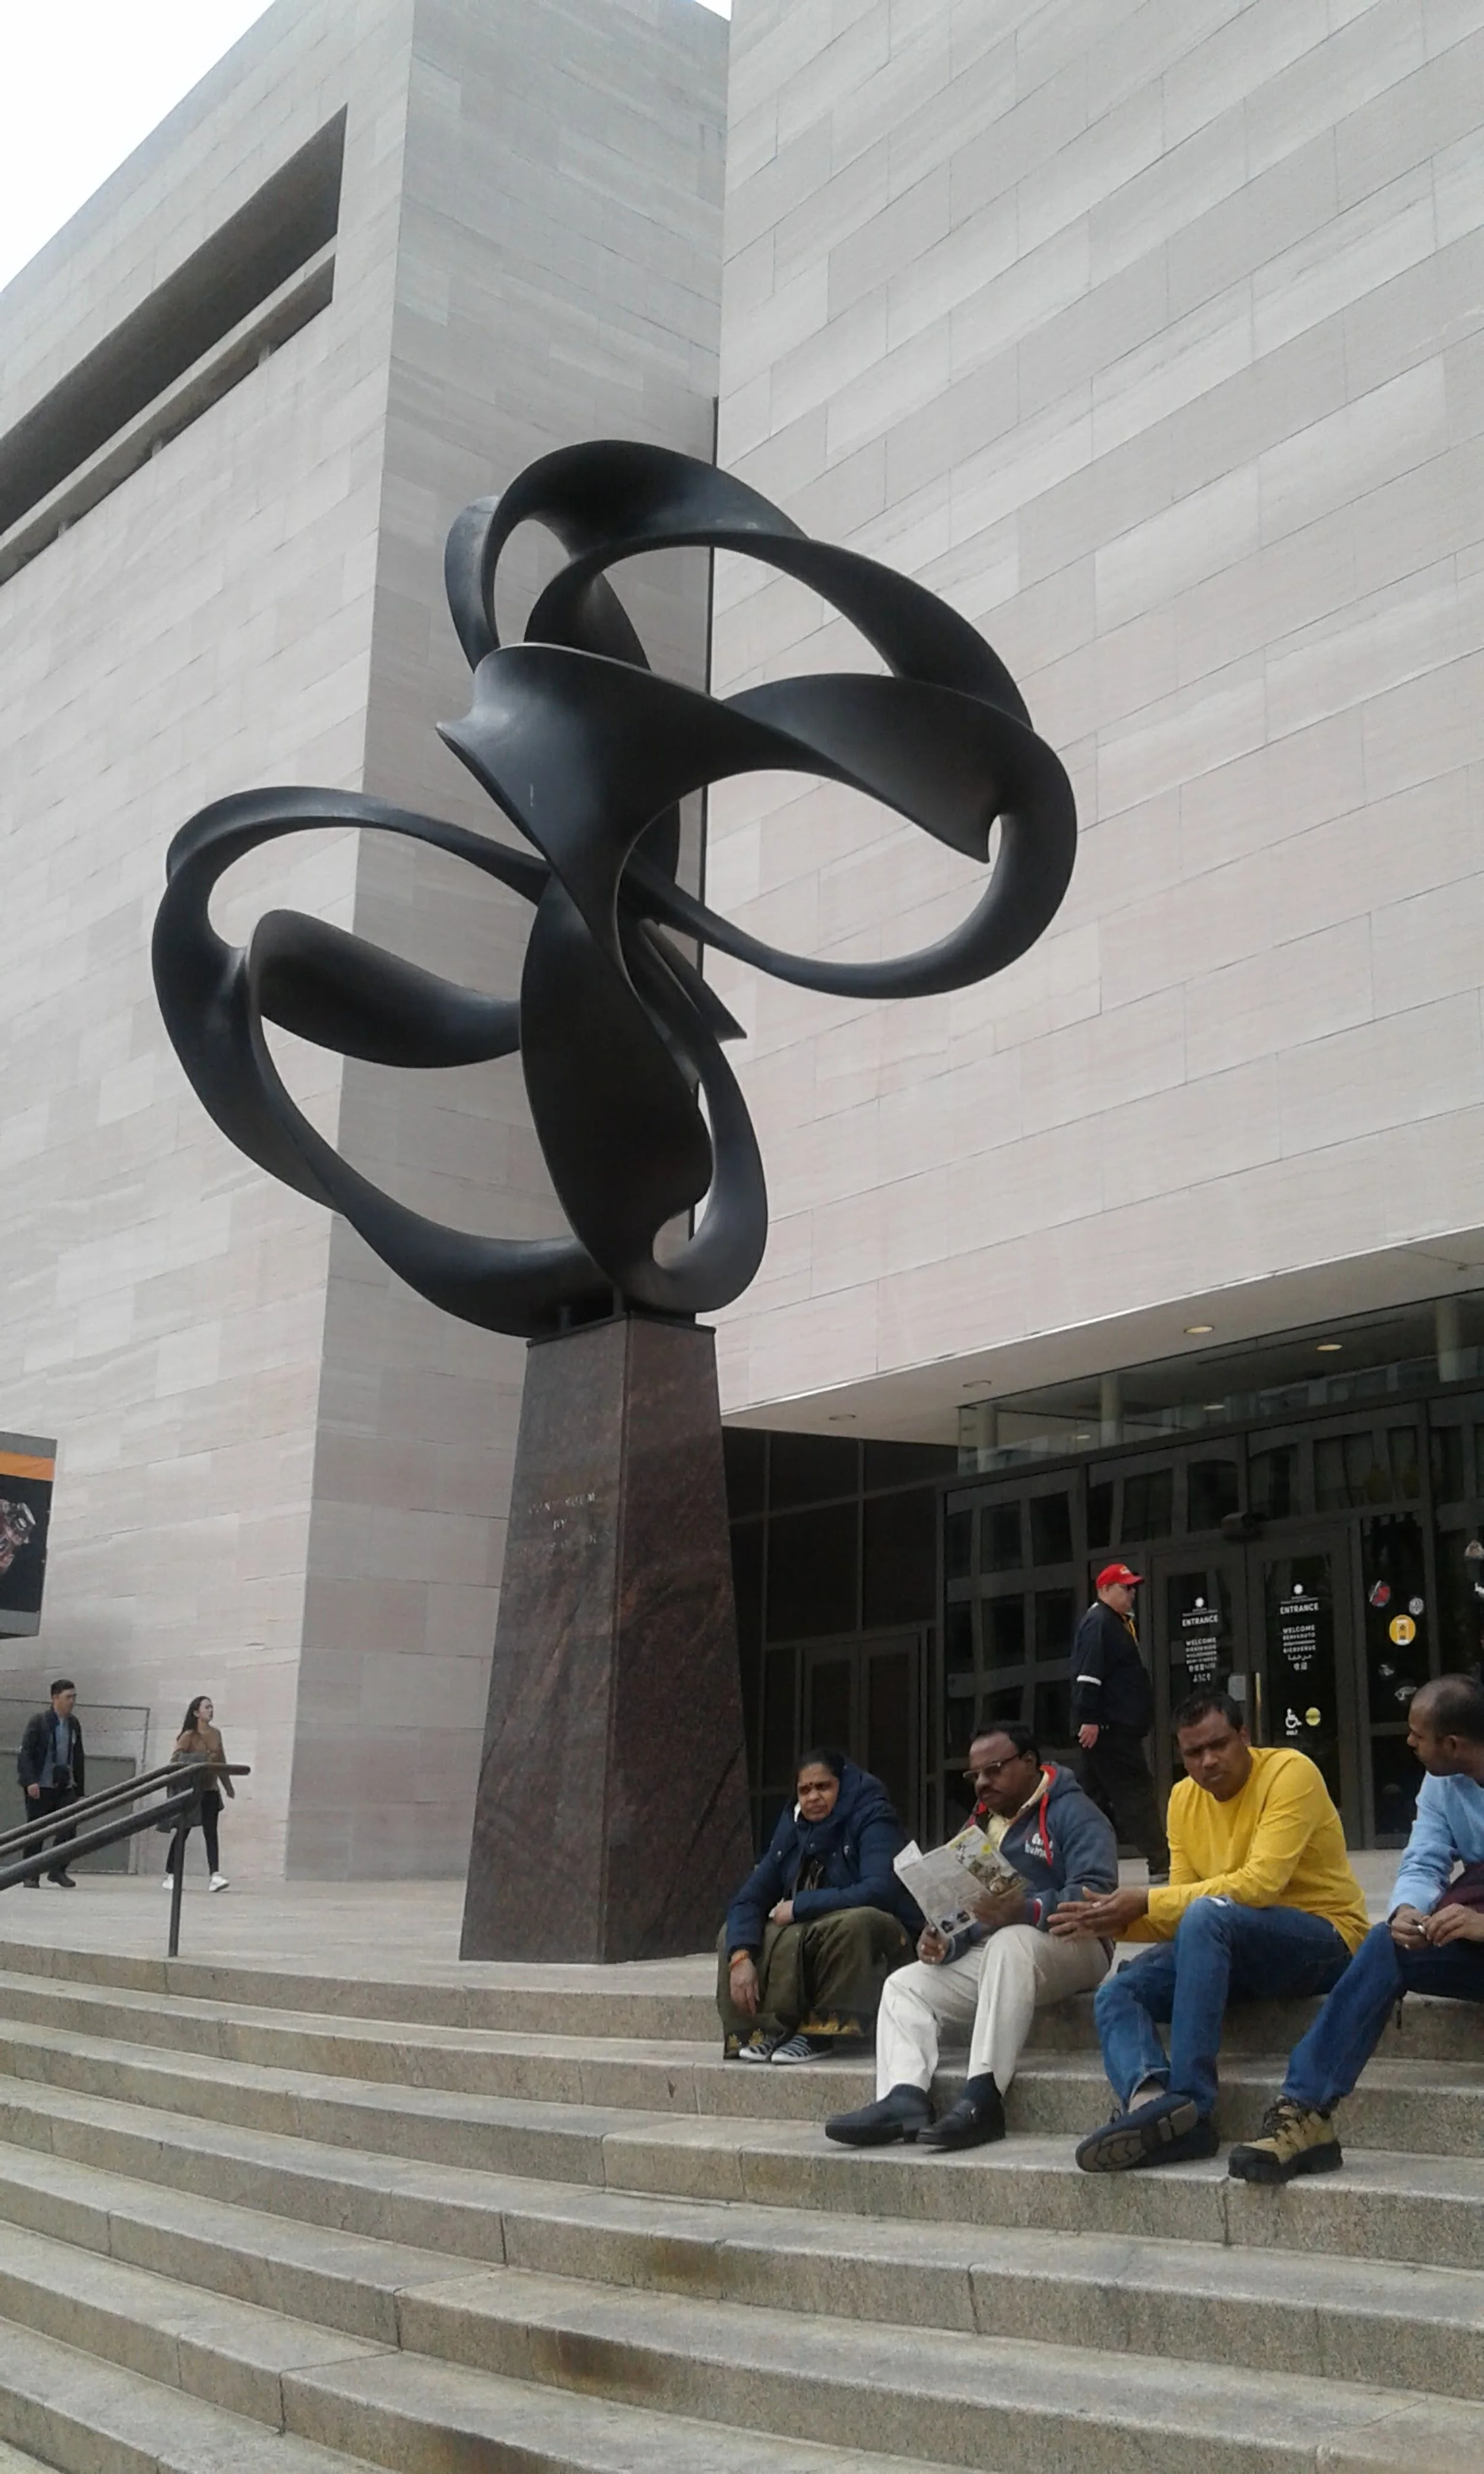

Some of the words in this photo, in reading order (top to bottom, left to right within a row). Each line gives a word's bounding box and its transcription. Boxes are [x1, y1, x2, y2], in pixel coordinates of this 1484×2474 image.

[1280, 1602, 1319, 1614] ENTRANCE
[1182, 1614, 1218, 1627] ENTRANCE
[1283, 1624, 1315, 1634] WELCOME
[1186, 1637, 1216, 1646] WELCOME
